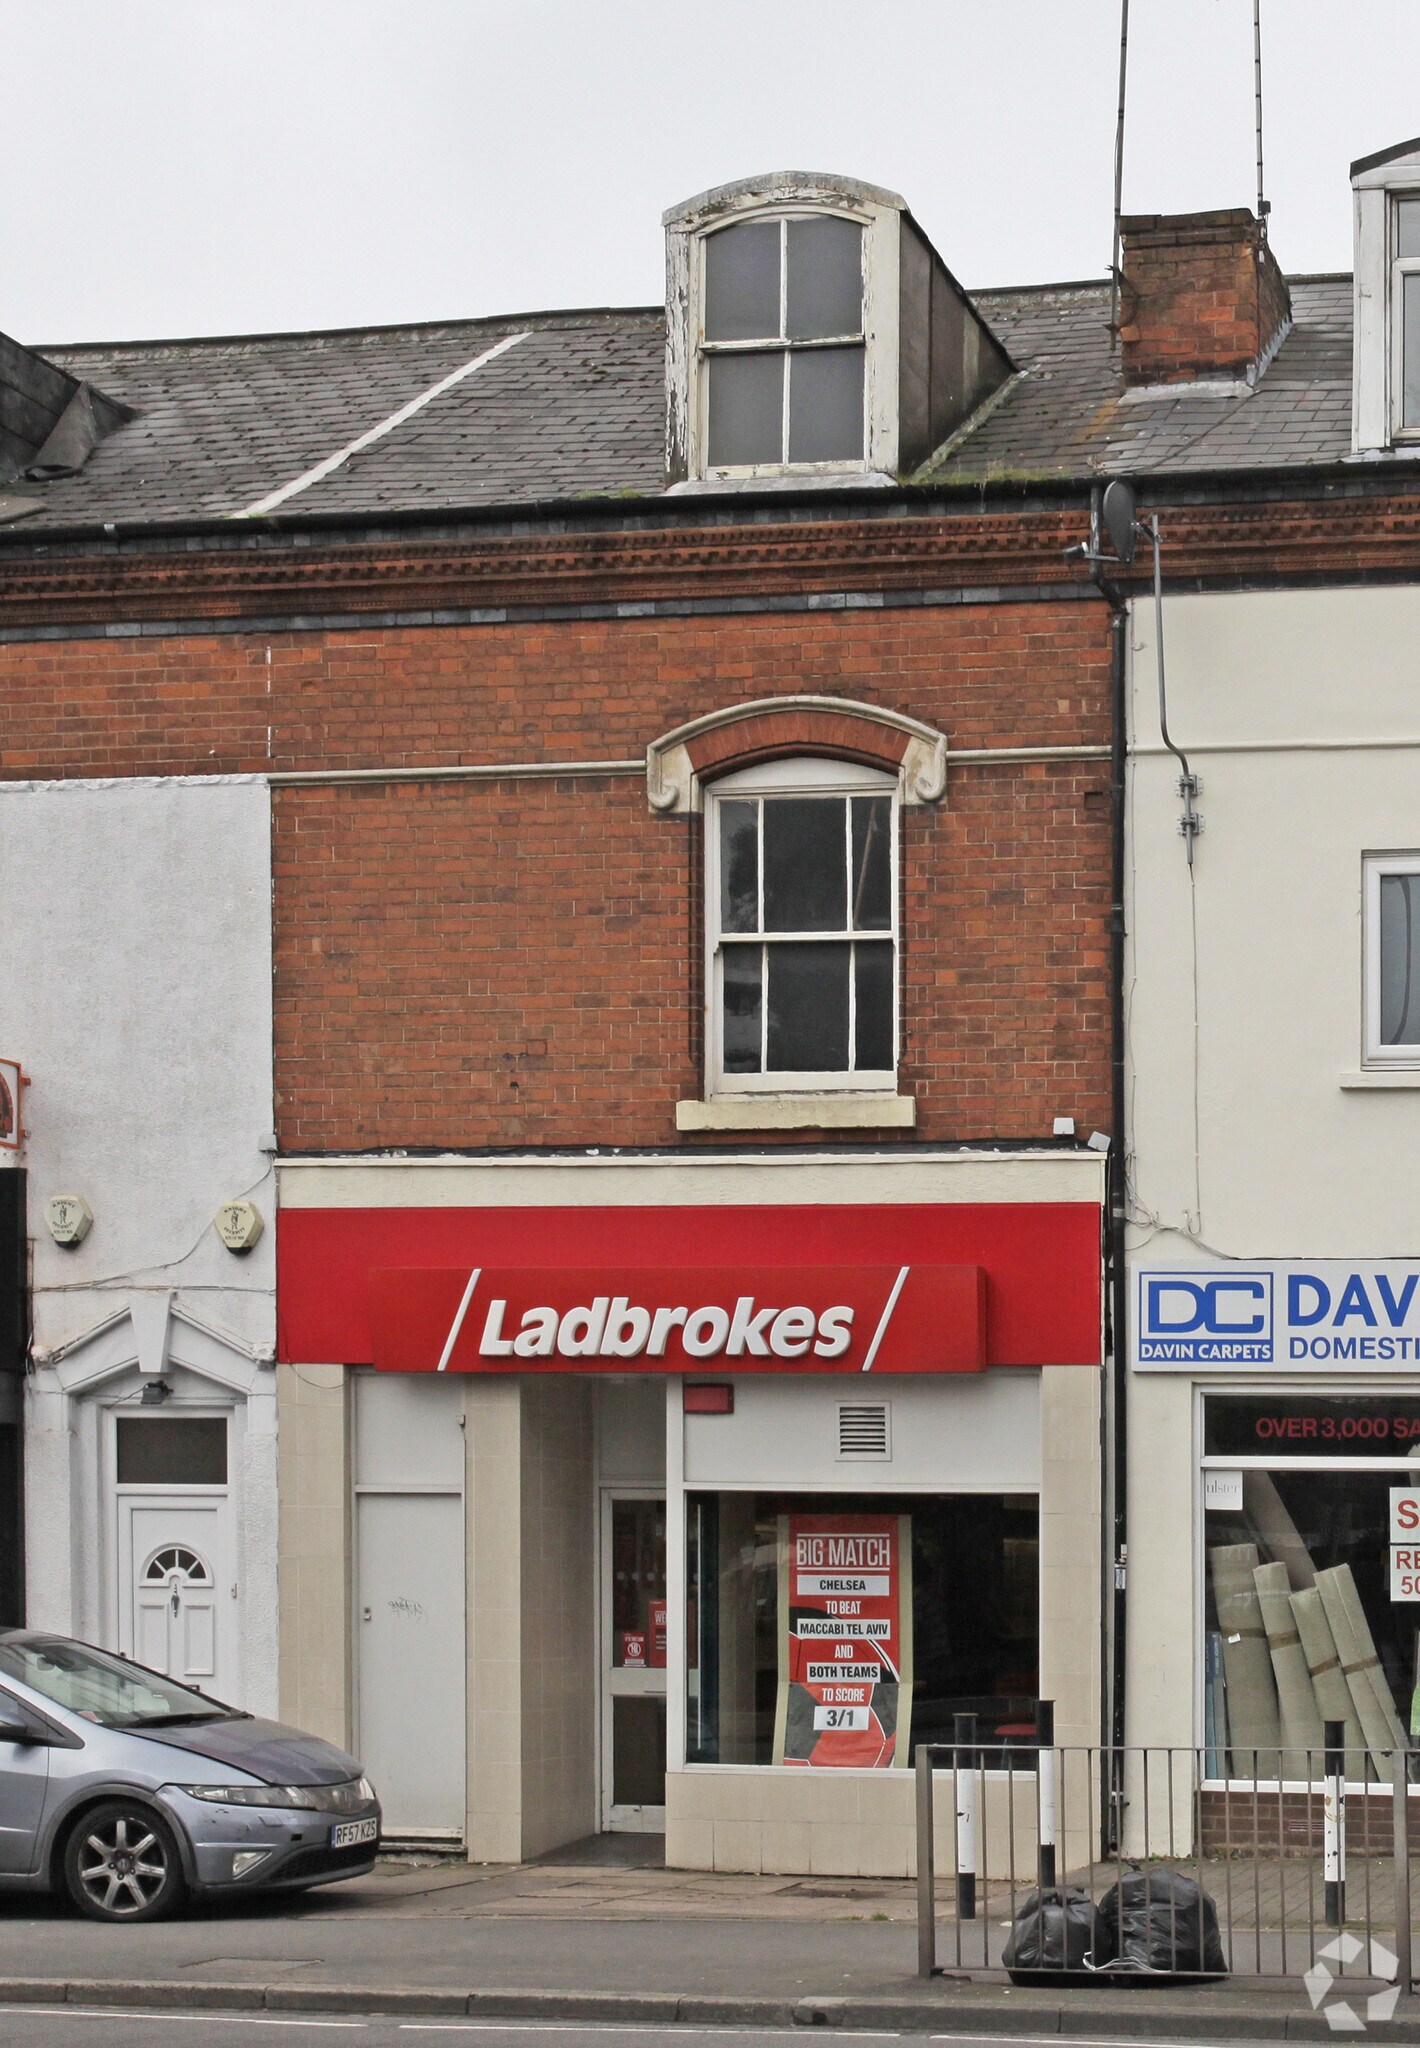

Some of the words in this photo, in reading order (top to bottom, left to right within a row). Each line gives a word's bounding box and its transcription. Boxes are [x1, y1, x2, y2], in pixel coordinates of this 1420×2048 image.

[223, 1206, 247, 1214] KNIGHT
[223, 1226, 246, 1235] SECURITY
[1148, 1281, 1264, 1334] DC
[1288, 1274, 1420, 1327] DAV
[479, 1297, 855, 1358] Ladbrokes
[1141, 1343, 1194, 1359] DAVIN
[1198, 1343, 1272, 1360] CARPETS
[1255, 1417, 1317, 1439] OVER
[1321, 1417, 1389, 1441] 3,000
[1206, 1480, 1240, 1494] ulster
[796, 1538, 824, 1567] BIG
[828, 1538, 890, 1567] MATCH
[819, 1579, 867, 1592] CHELSEA
[826, 1600, 838, 1615] TO
[839, 1600, 861, 1615] BEAT
[800, 1623, 845, 1636] MACCABI
[846, 1623, 865, 1636] TEL
[866, 1623, 888, 1636] AVIV
[834, 1644, 854, 1659] AND
[809, 1666, 838, 1678] BOTH
[840, 1665, 879, 1678] TEAMS
[822, 1688, 834, 1702] TO
[835, 1687, 864, 1702] SCORE
[826, 1709, 855, 1727] 3/1
[336, 1824, 359, 1844] RF57
[360, 1820, 376, 1840] KZS
